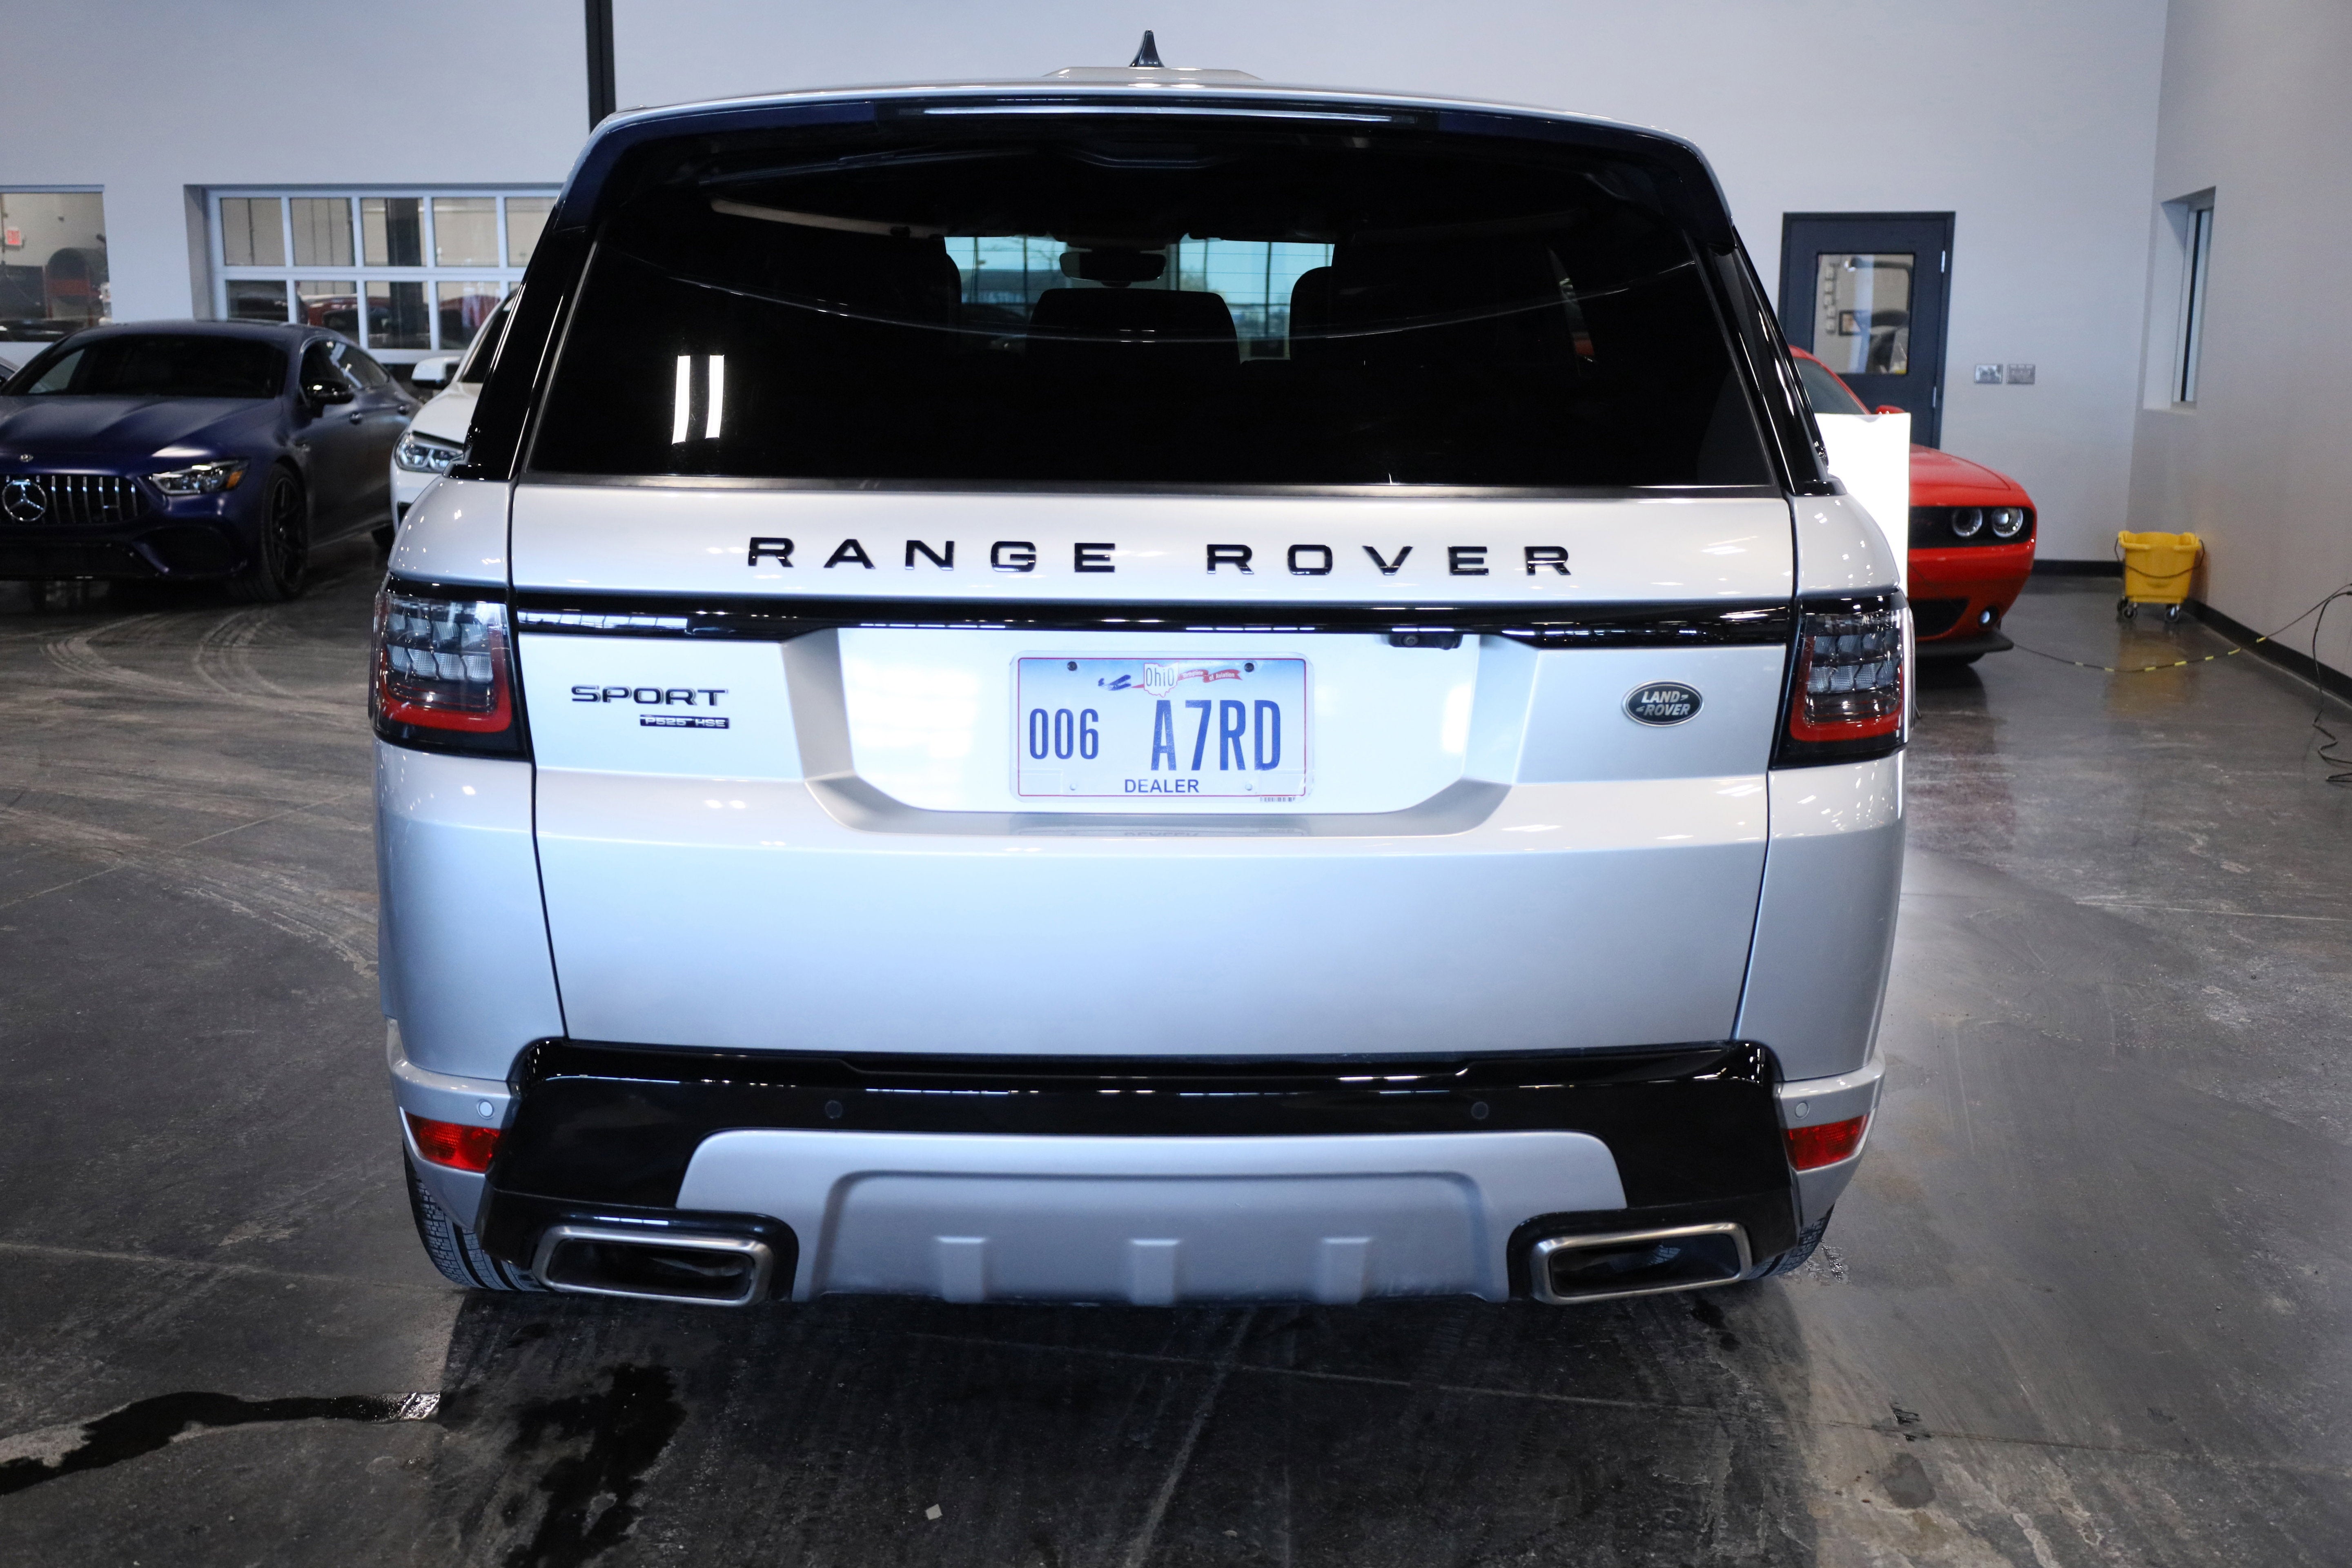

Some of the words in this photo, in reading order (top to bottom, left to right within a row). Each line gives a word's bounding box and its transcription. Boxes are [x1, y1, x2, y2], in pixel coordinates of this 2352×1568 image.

[748, 537, 1116, 572] RANGE
[1206, 544, 1571, 575] ROVER
[571, 685, 728, 706] SPORT
[1641, 691, 1680, 703] LAND
[1644, 704, 1690, 715] ROVER
[645, 717, 686, 726] P525
[695, 719, 726, 727] HSE
[1029, 708, 1098, 759] 006
[1150, 699, 1280, 771] A7RD
[1124, 779, 1199, 793] DEALER
